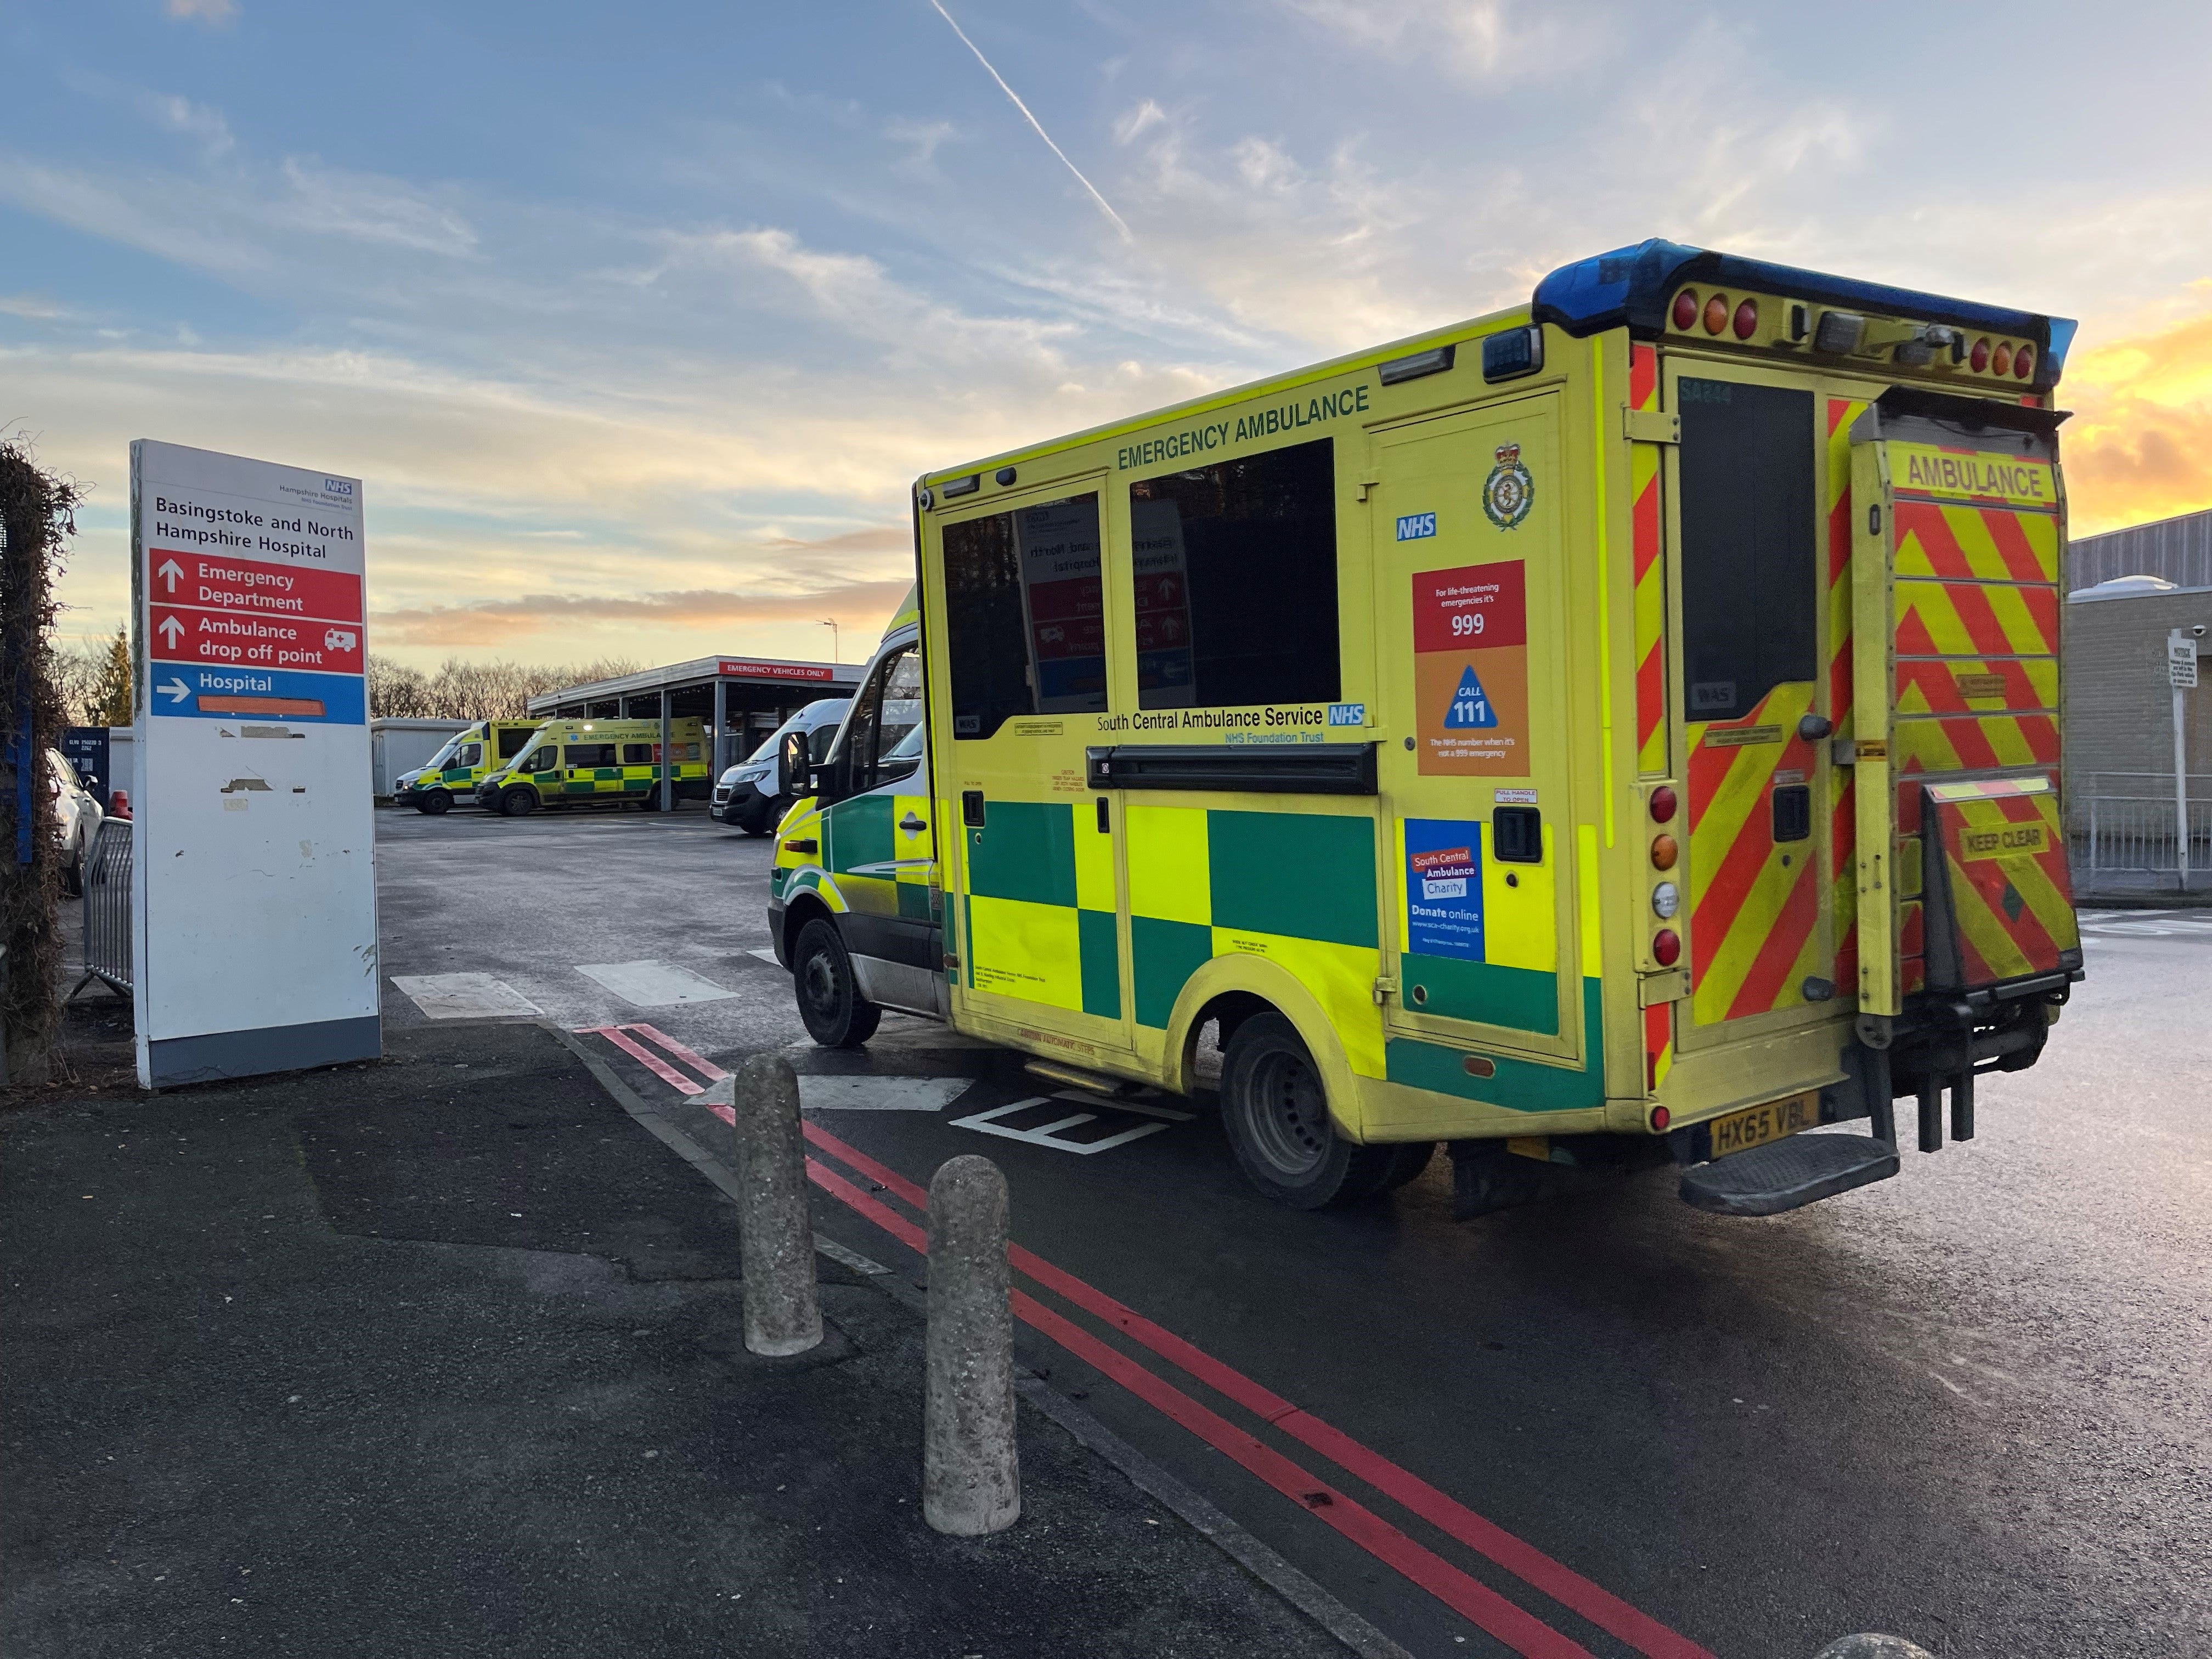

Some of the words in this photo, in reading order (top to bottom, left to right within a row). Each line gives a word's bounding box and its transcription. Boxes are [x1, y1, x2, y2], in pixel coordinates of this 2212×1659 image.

[1118, 421, 1229, 471] EMERGENCY
[1235, 385, 1369, 443] AMBULANCE
[1909, 454, 2043, 496] AMBULANCE
[279, 485, 318, 498] Hampshire
[320, 492, 352, 504] Hospitals
[326, 479, 352, 494] NHS
[156, 497, 263, 526] Basingstoke
[271, 517, 301, 533] and
[308, 521, 353, 540] North
[1398, 514, 1435, 539] NHS
[156, 522, 251, 548] Hampshire
[259, 536, 325, 558] Hospital
[199, 563, 294, 591] Emergency
[199, 585, 303, 611] Department
[1436, 589, 1447, 597] For
[1448, 583, 1499, 596] life-threatening
[1441, 596, 1483, 608] emergencies
[1483, 594, 1494, 602] it's
[199, 617, 297, 640] Ambulance
[1452, 613, 1484, 636] 999
[199, 640, 242, 661] drop
[247, 645, 273, 660] off
[279, 648, 323, 664] point
[727, 664, 771, 673] EMERGENCY
[200, 673, 272, 693] Hospital
[1458, 687, 1481, 697] CALL
[1097, 715, 1128, 731] South
[1133, 711, 1178, 730] Central
[1182, 708, 1261, 729] Ambulance
[1265, 706, 1323, 726] Service
[1329, 705, 1364, 726] NHS
[1454, 701, 1485, 723] 111
[1225, 732, 1244, 744] NHS
[1247, 732, 1297, 743] Foundation
[1301, 731, 1324, 743] Trust
[1469, 750, 1506, 759] emergency
[1967, 833, 1999, 852] KEEP
[2002, 828, 2041, 849] CLEAR
[1414, 855, 1438, 867] South
[1440, 850, 1469, 863] Central
[1426, 866, 1475, 878] Ambulance
[1427, 882, 1463, 895] Charity
[1412, 904, 1447, 918] Donate
[1448, 909, 1479, 921] online
[1412, 922, 1480, 934] www.sca-charity.org.uk
[1078, 1043, 1095, 1055] STEPS
[1718, 1110, 1771, 1151] HX65
[1776, 1099, 1809, 1133] VBL
